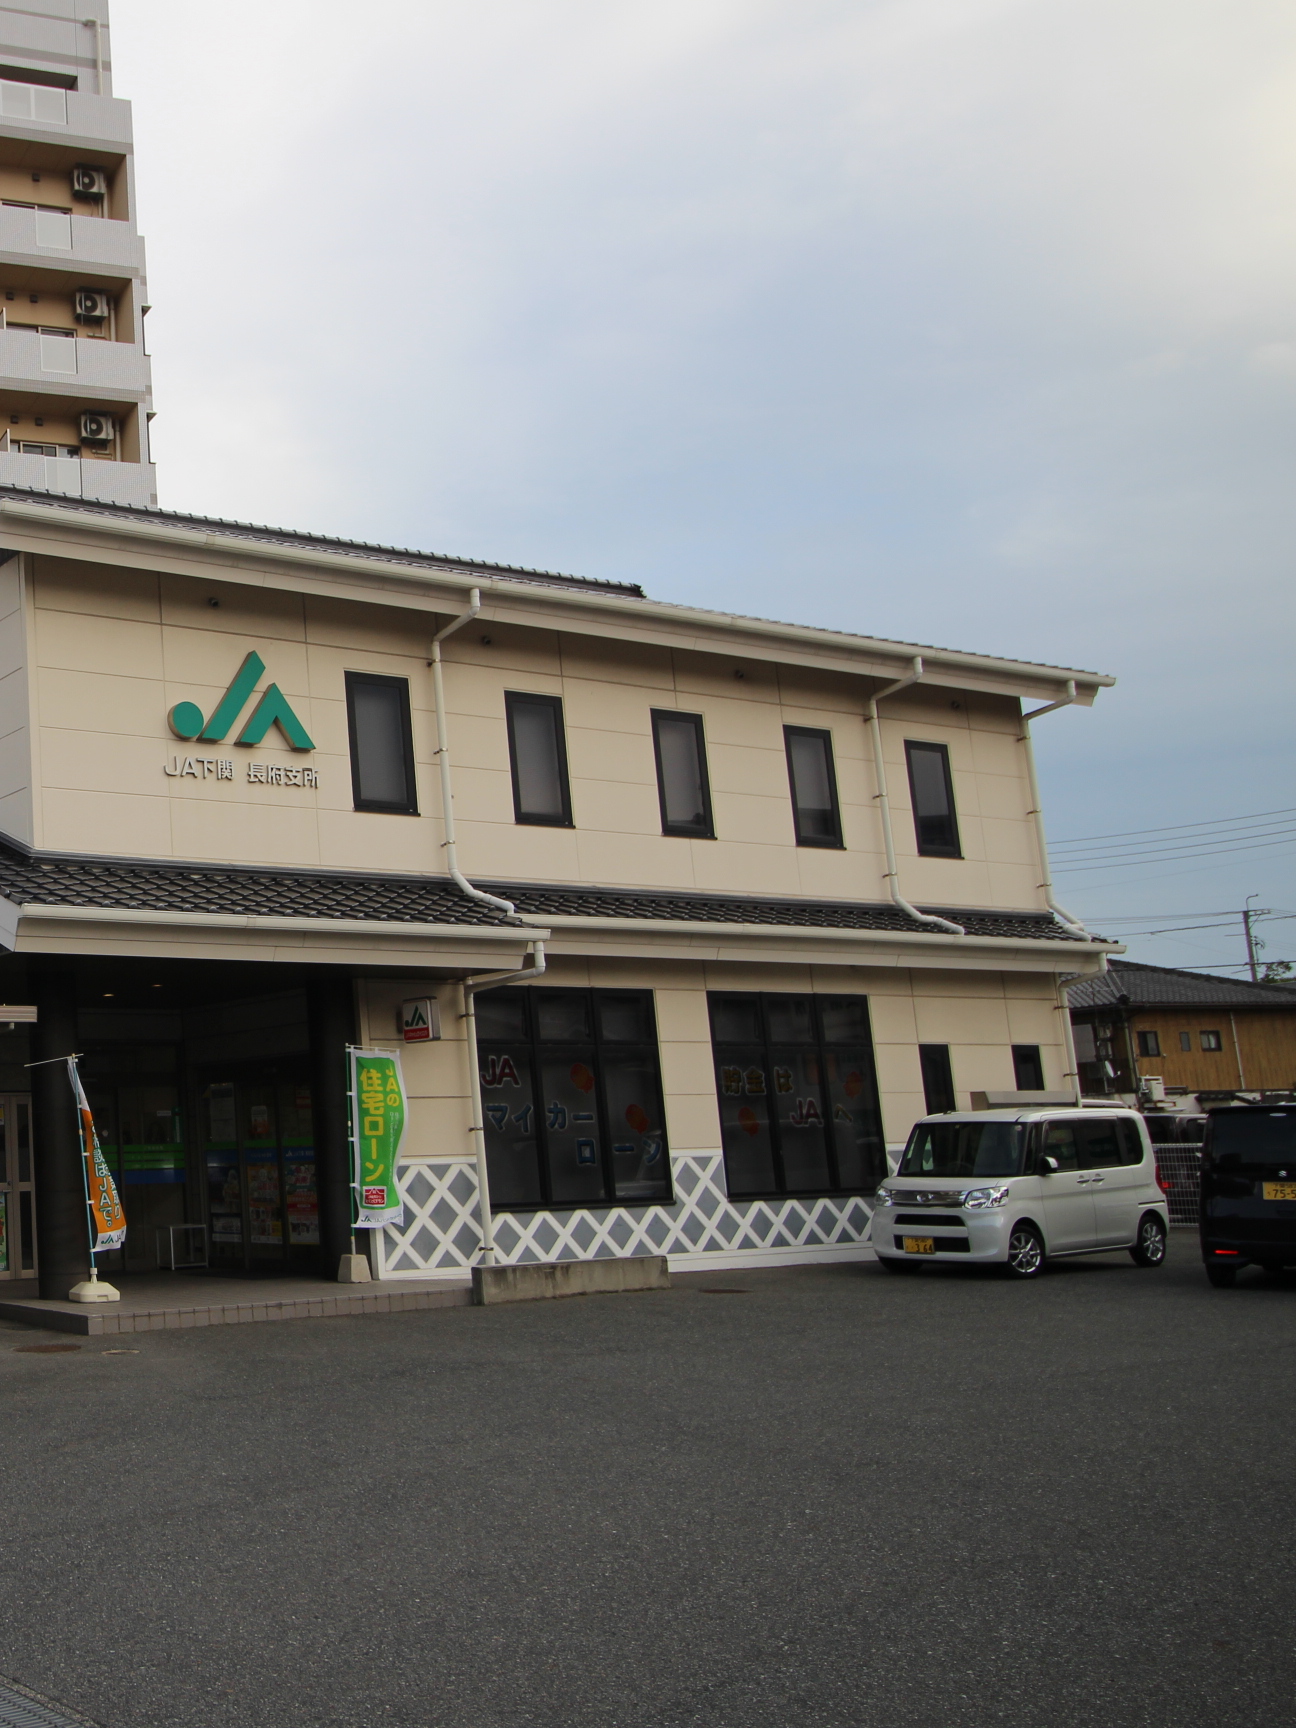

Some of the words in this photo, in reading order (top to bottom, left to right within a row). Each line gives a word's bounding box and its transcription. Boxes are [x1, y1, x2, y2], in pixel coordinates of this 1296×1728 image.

[164, 756, 234, 780] JA下関
[247, 762, 320, 788] 長府支所
[385, 1063, 401, 1107] JAの
[480, 1055, 522, 1088] JA
[721, 1065, 794, 1096] 貯金は
[359, 1068, 386, 1182] 住宅ローン
[485, 1101, 595, 1135] マイカー
[790, 1098, 854, 1127] JAへ
[576, 1137, 663, 1167] ローン
